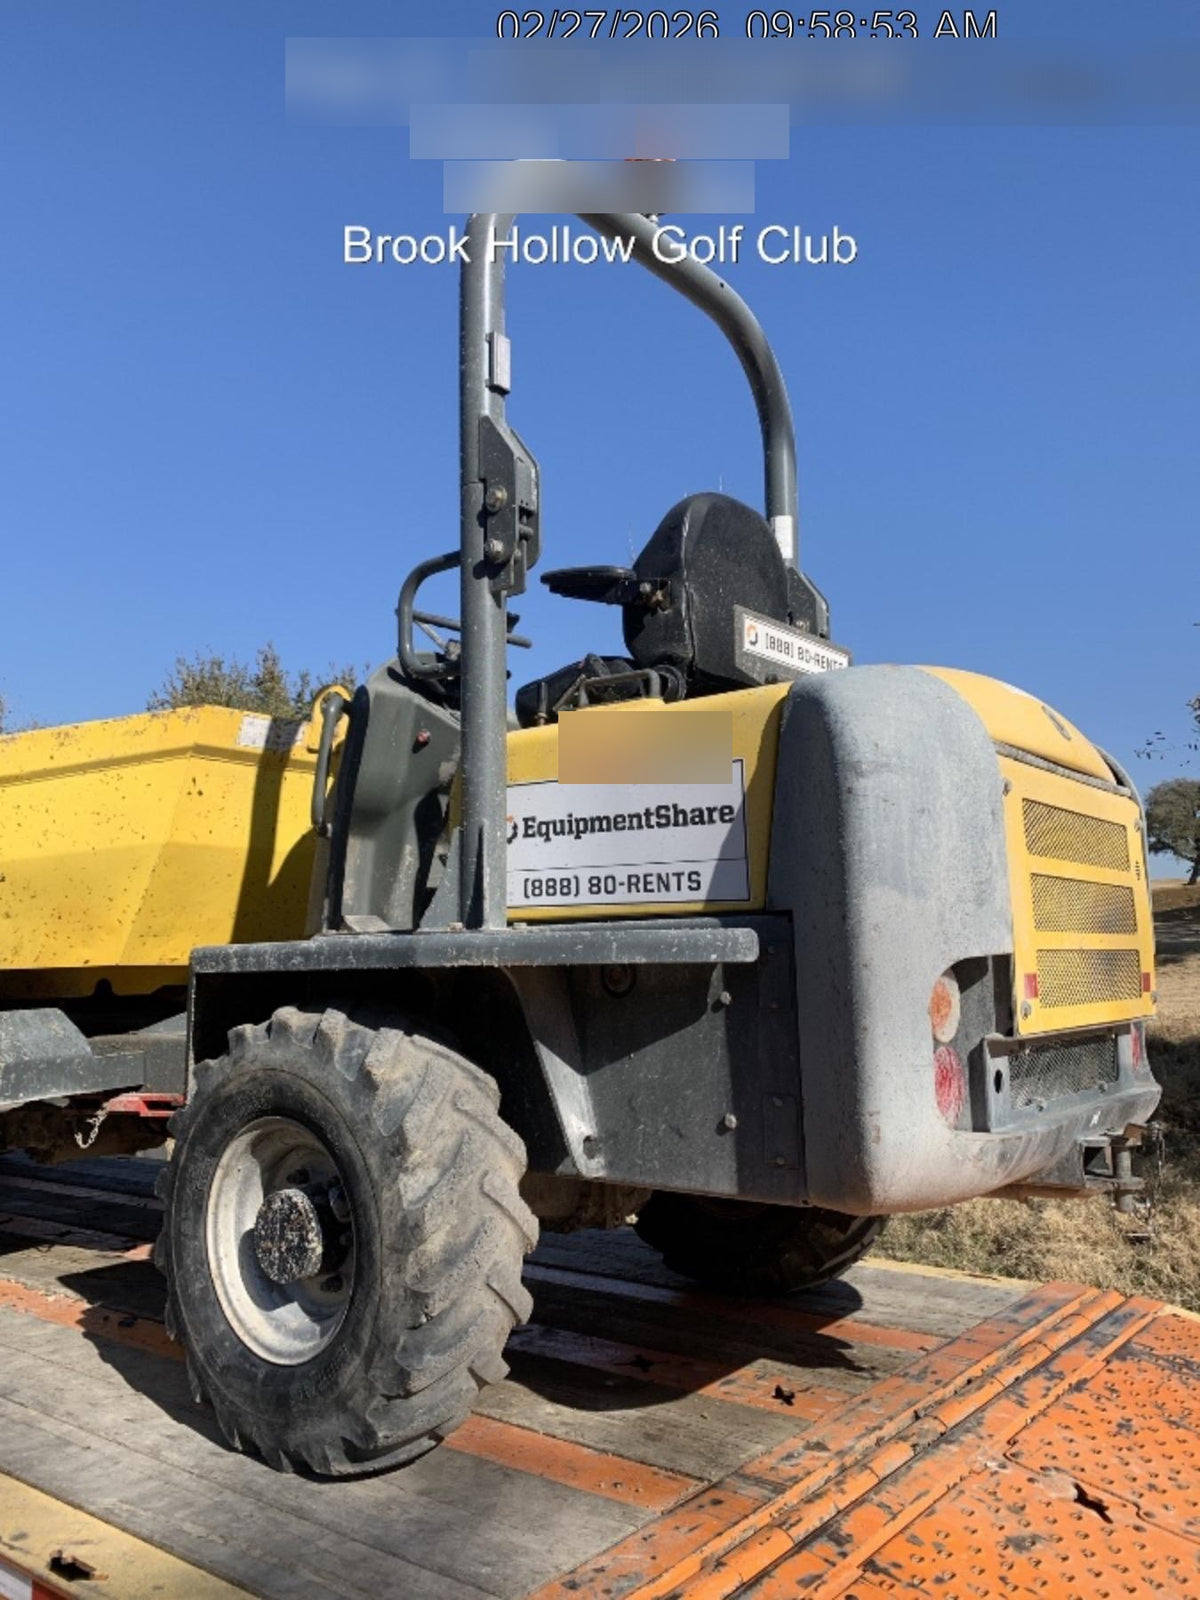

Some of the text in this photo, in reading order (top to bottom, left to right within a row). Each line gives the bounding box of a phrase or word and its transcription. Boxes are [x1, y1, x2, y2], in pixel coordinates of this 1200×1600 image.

[797, 646, 844, 671] 80-RENT
[522, 803, 735, 842] EquipmentShare
[523, 870, 702, 899] (888) 80-RENTS
